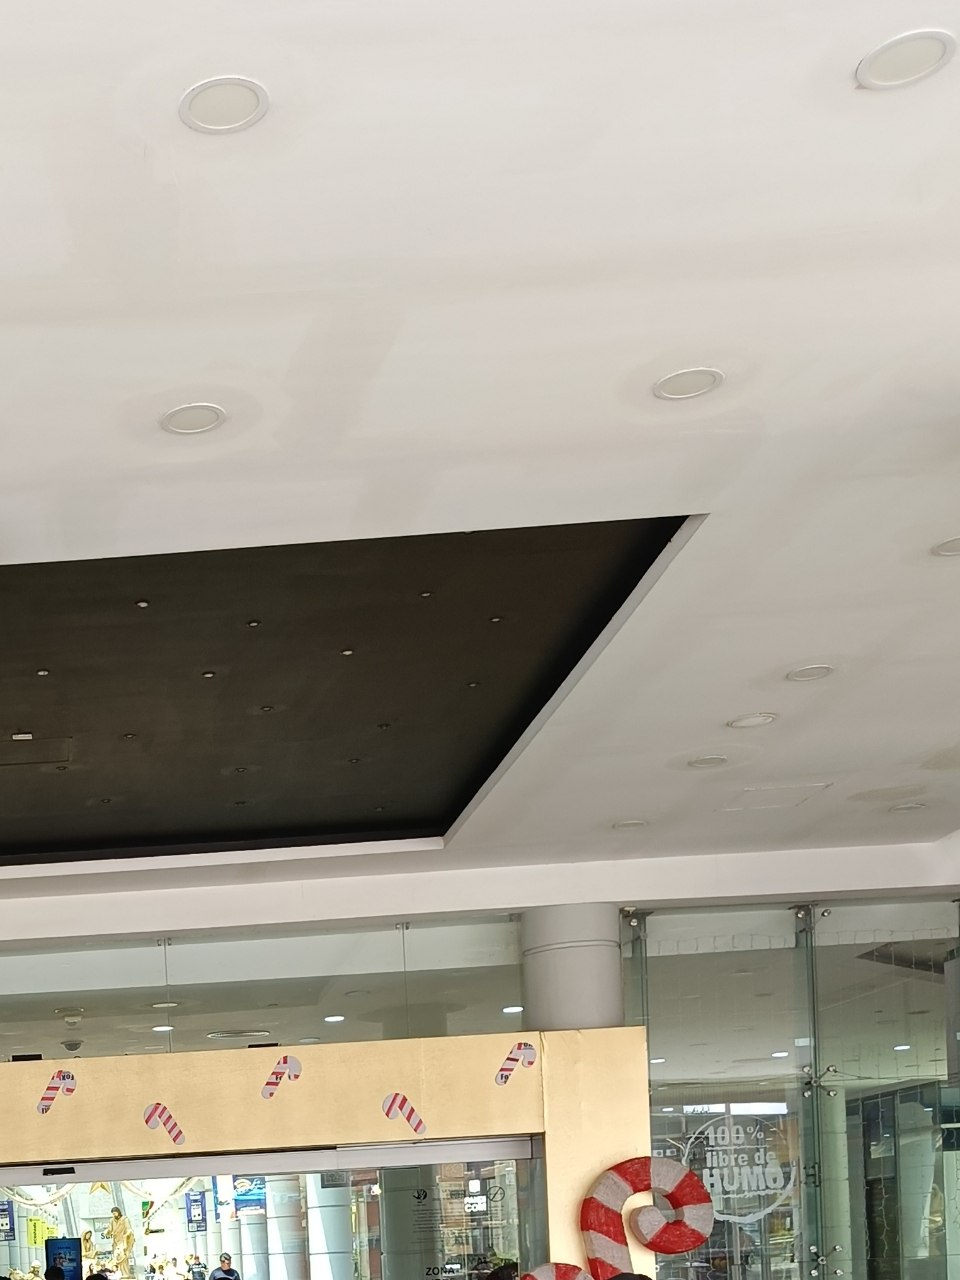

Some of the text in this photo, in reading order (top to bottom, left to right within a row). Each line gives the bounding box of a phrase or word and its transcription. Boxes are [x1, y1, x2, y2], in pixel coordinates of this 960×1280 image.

[704, 1125, 765, 1146] 100%
[706, 1148, 777, 1168] libre de
[703, 1164, 785, 1195] HUMO
[425, 1266, 456, 1277] ZONA
